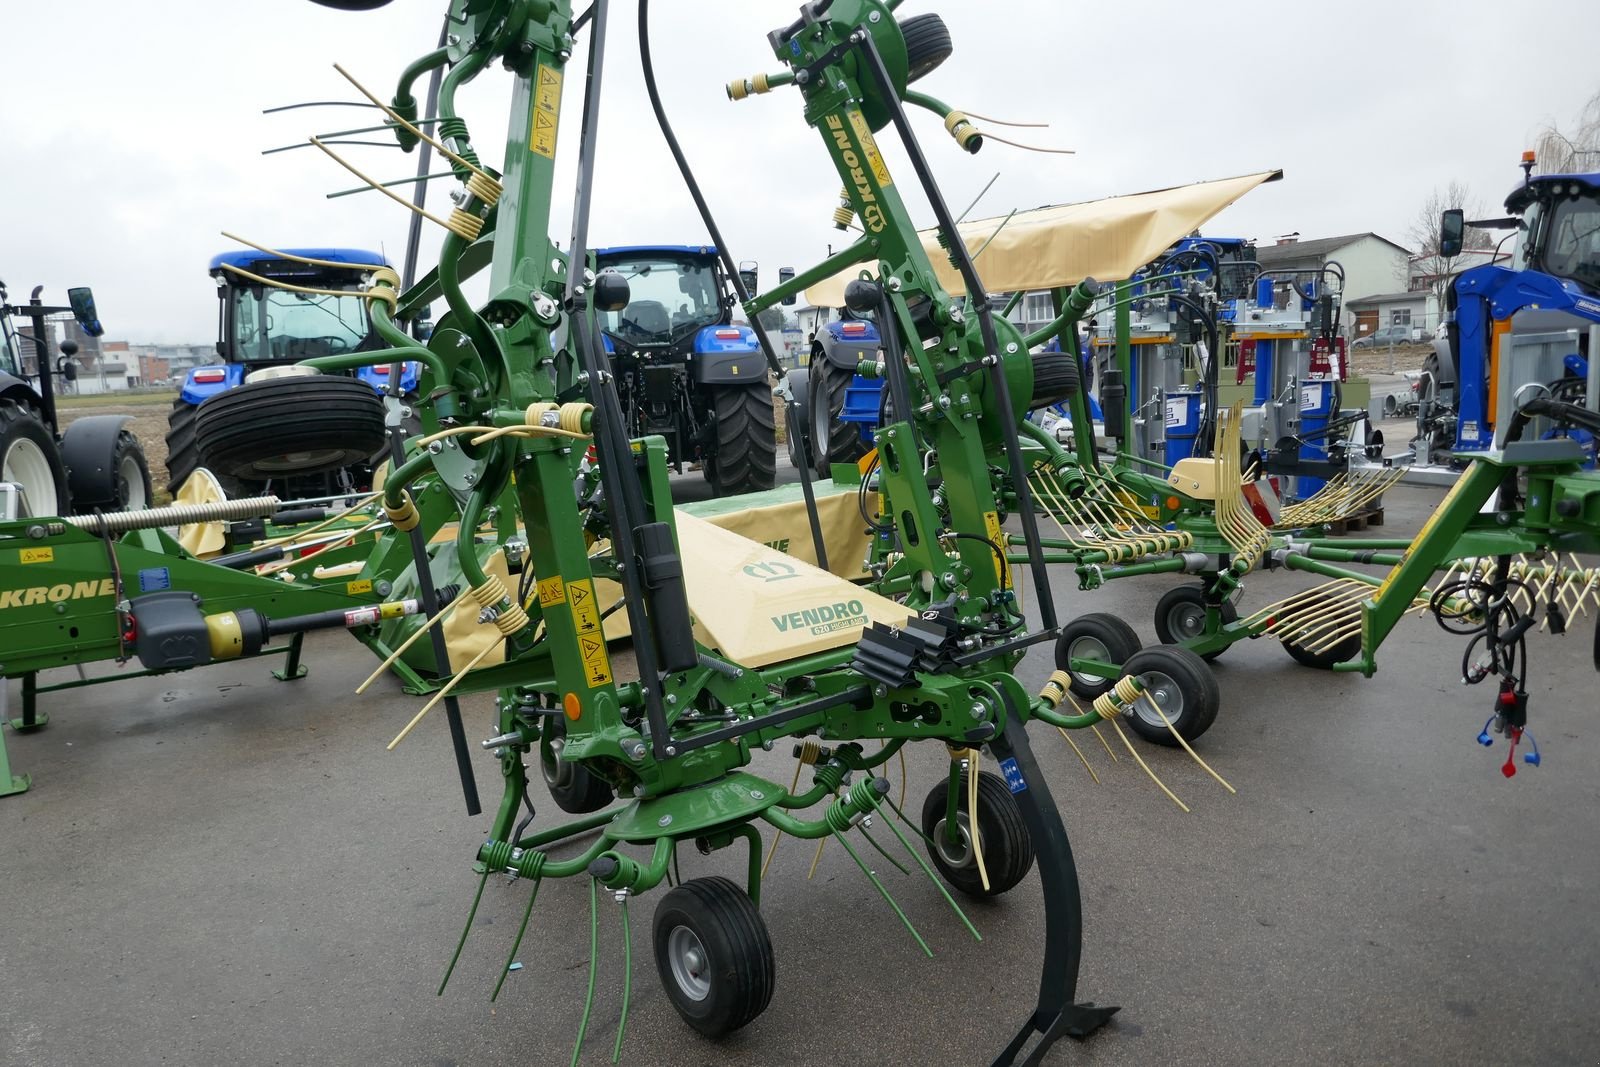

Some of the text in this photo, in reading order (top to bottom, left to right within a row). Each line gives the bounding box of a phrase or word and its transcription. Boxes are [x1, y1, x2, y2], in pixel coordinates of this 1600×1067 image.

[825, 114, 876, 202] KRONE
[0, 578, 116, 609] KRONE
[771, 599, 864, 632] VENDRO
[814, 624, 830, 635] 620
